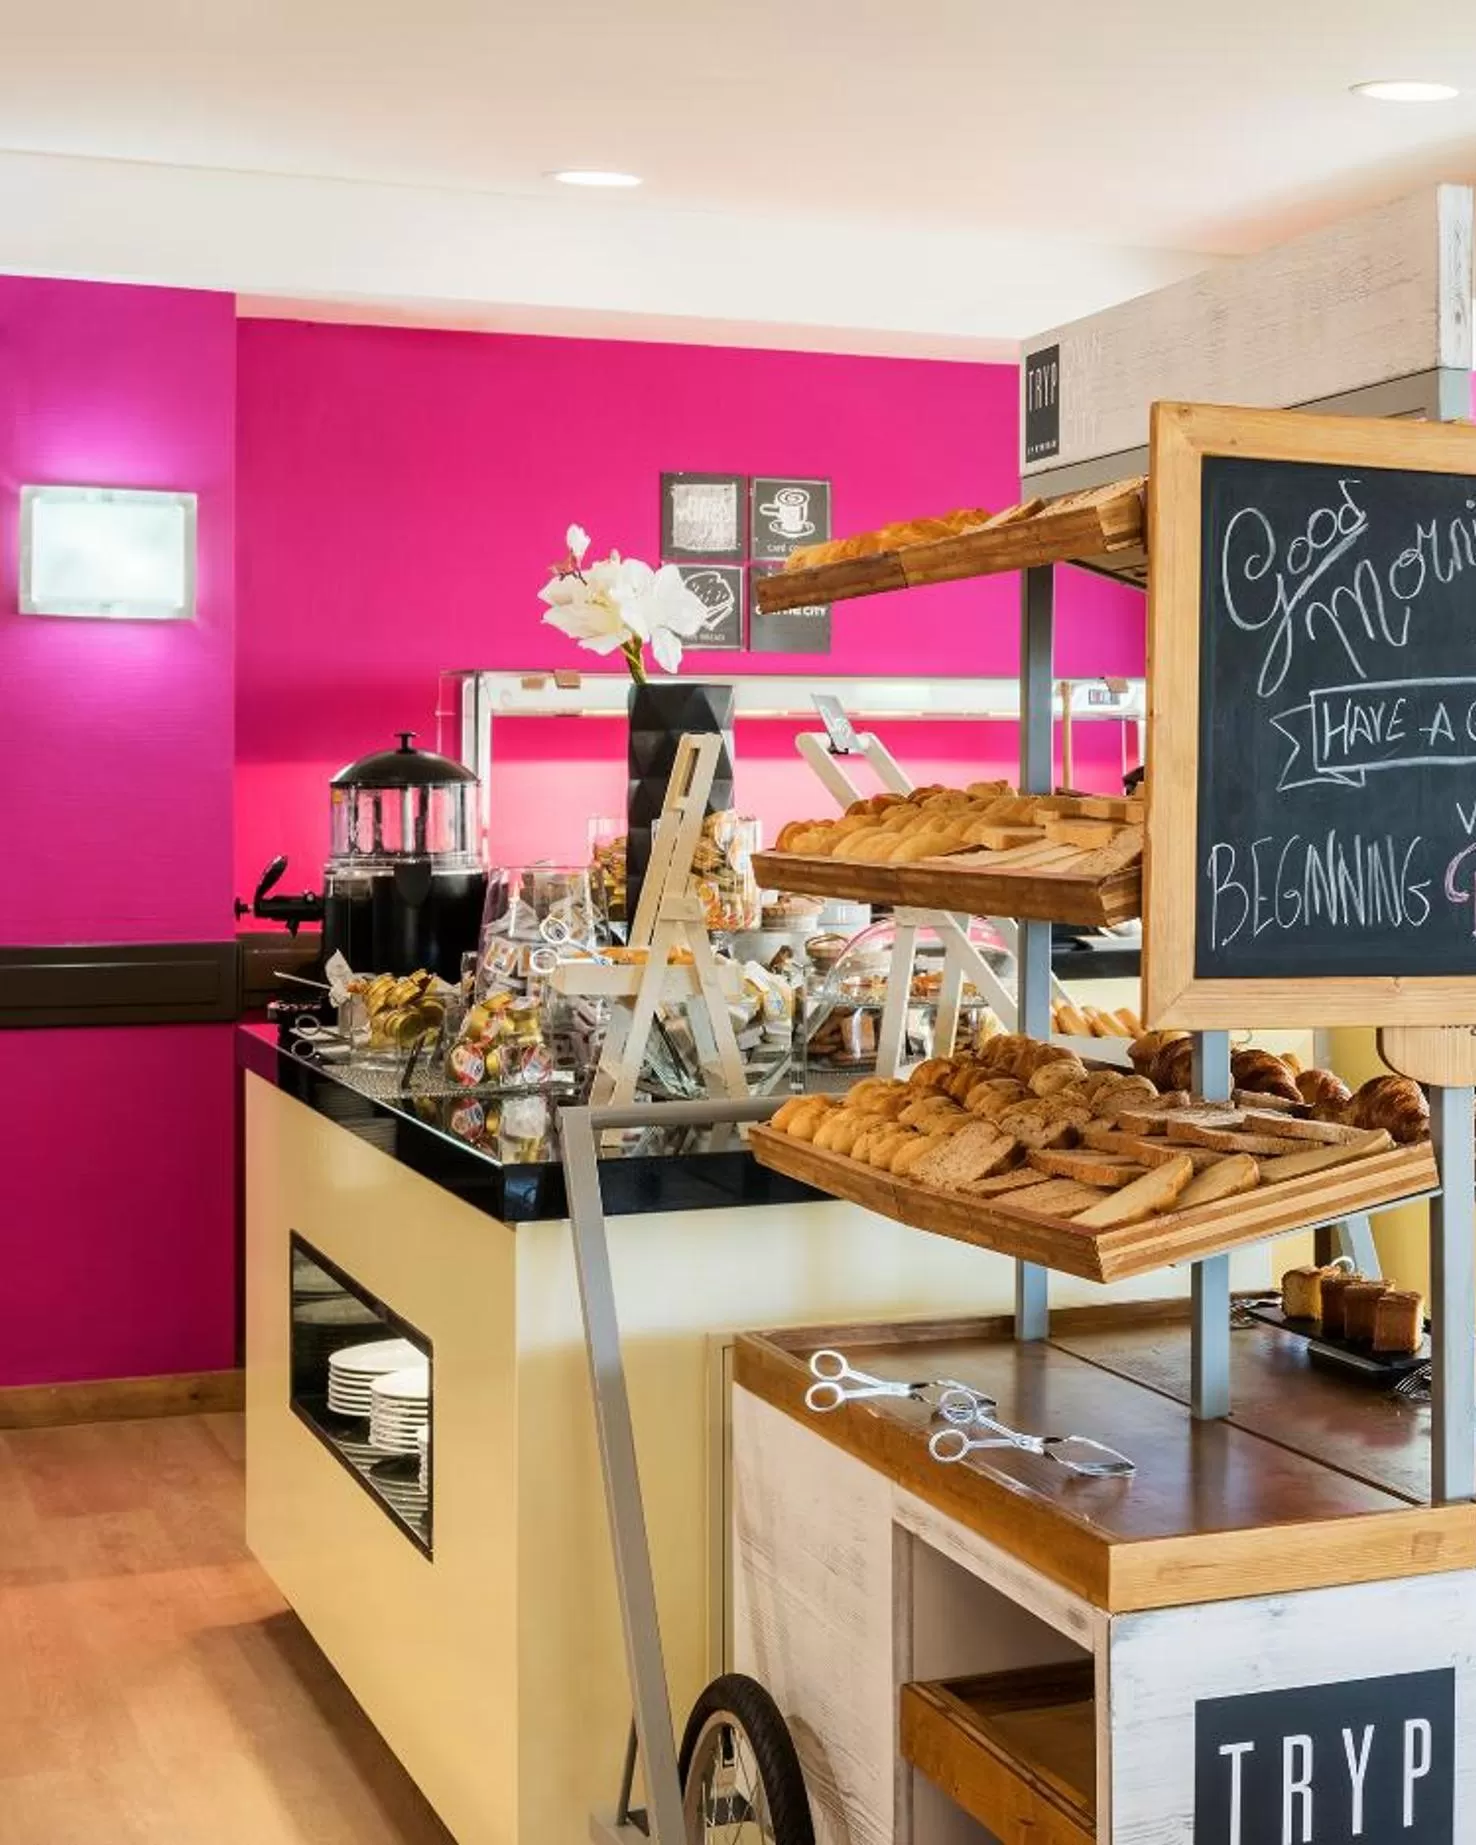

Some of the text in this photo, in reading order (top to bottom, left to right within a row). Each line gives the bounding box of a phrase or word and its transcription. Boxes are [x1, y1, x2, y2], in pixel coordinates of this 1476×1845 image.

[1029, 362, 1057, 411] TRYP
[1222, 480, 1368, 697] Good
[1322, 698, 1406, 760] HAVE
[1419, 702, 1455, 746] A
[1218, 1717, 1432, 1845] TRYP
